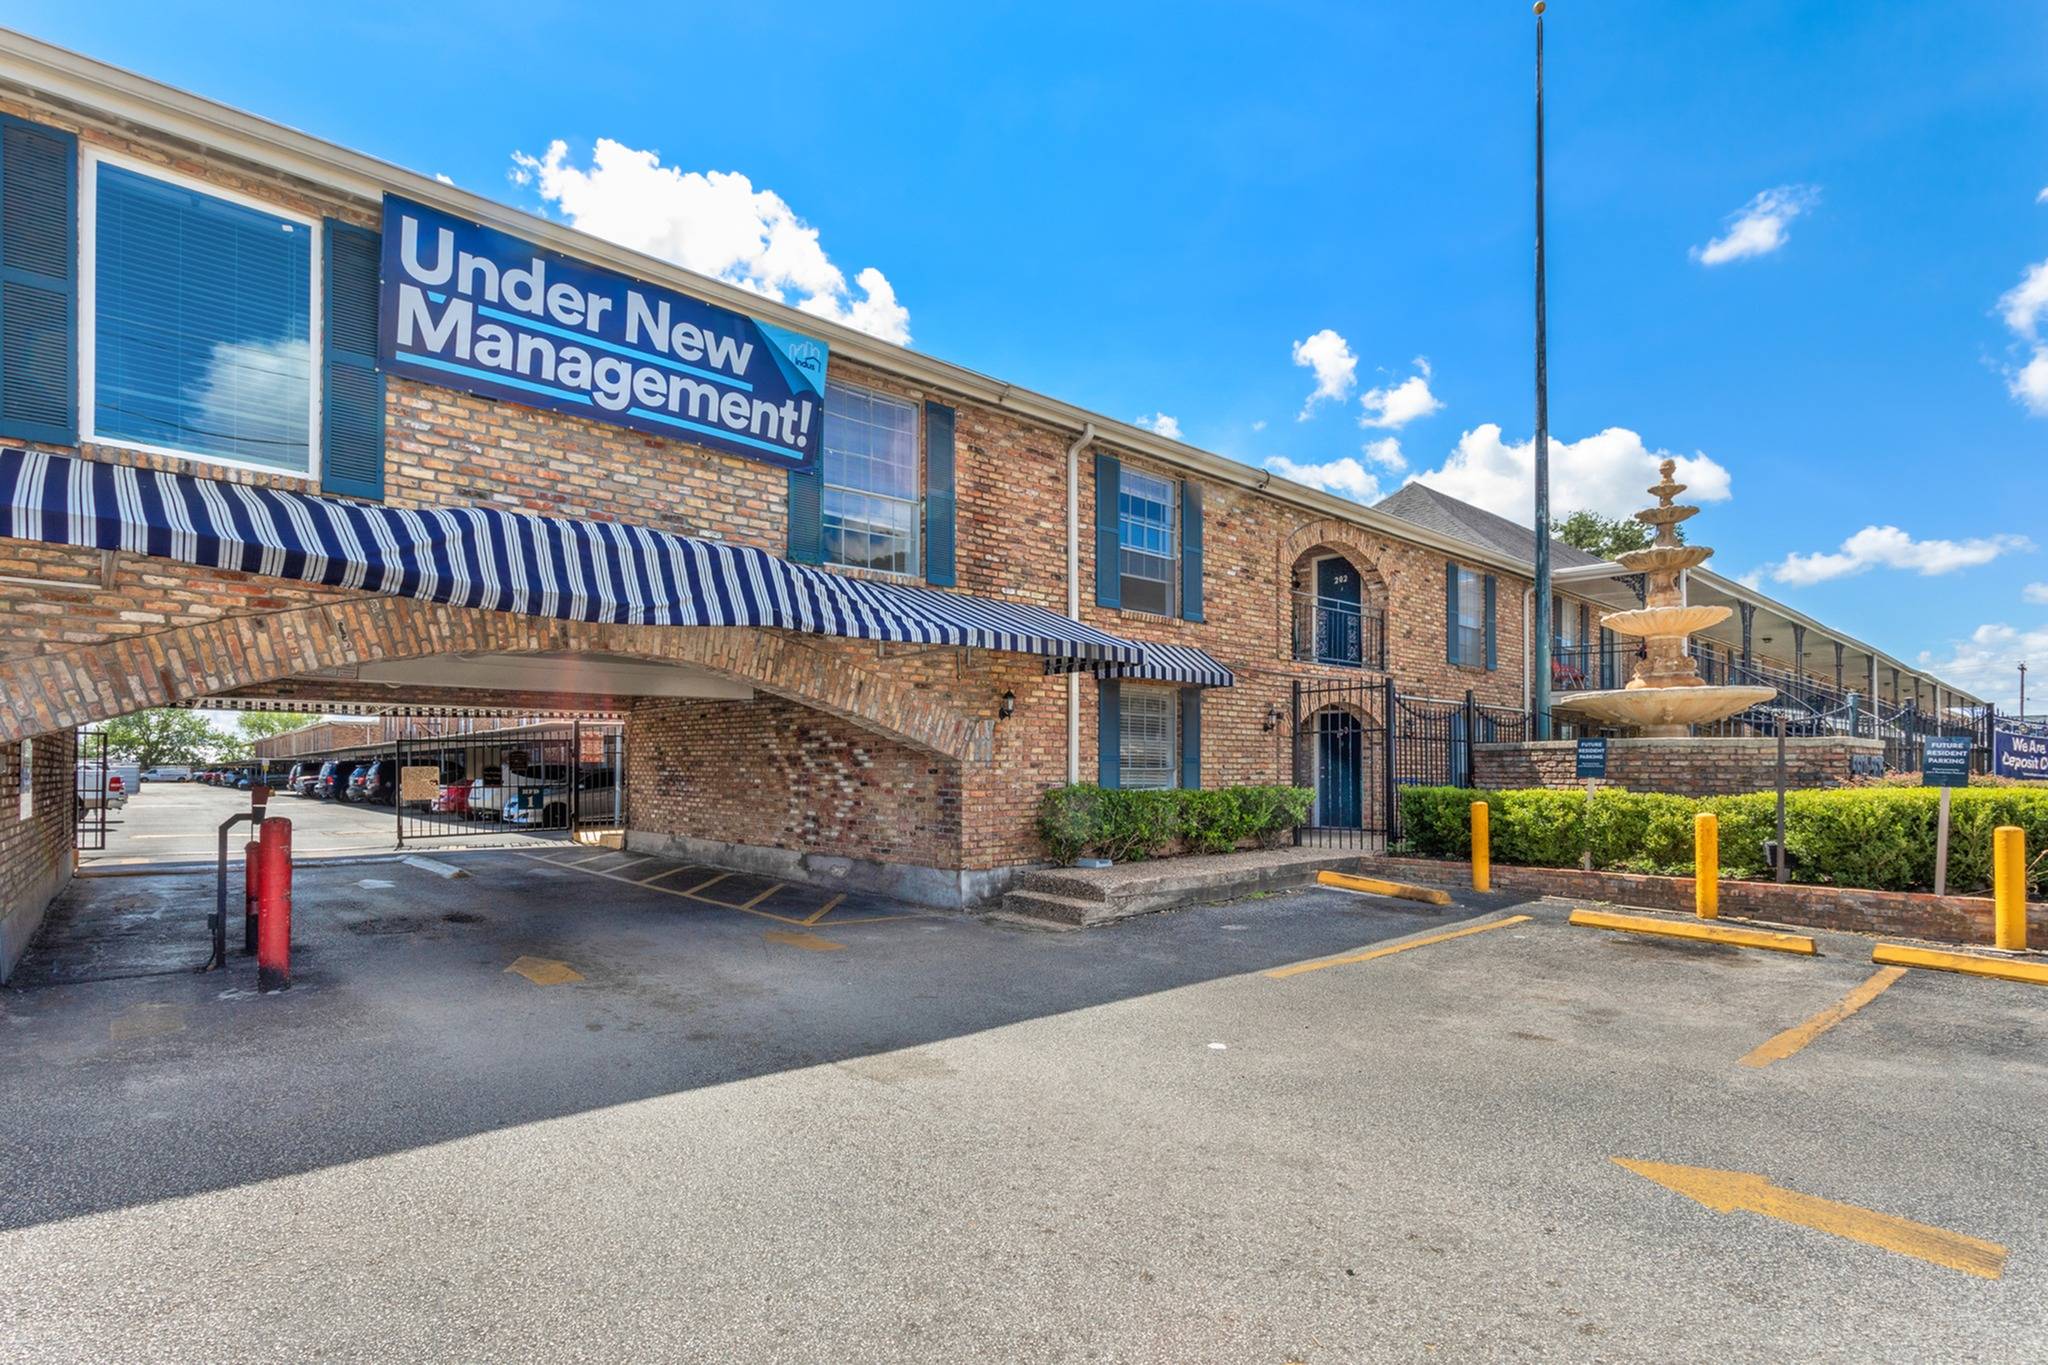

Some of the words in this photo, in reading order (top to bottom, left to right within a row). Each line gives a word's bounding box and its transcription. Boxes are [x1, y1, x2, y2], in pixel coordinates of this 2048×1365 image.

[401, 215, 612, 333] Under
[625, 289, 754, 377] New
[397, 283, 812, 448] Management!
[2012, 736, 2028, 752] We
[2029, 739, 2047, 755] Are
[1928, 757, 1966, 765] PARKING
[2002, 751, 2039, 771] Deposit
